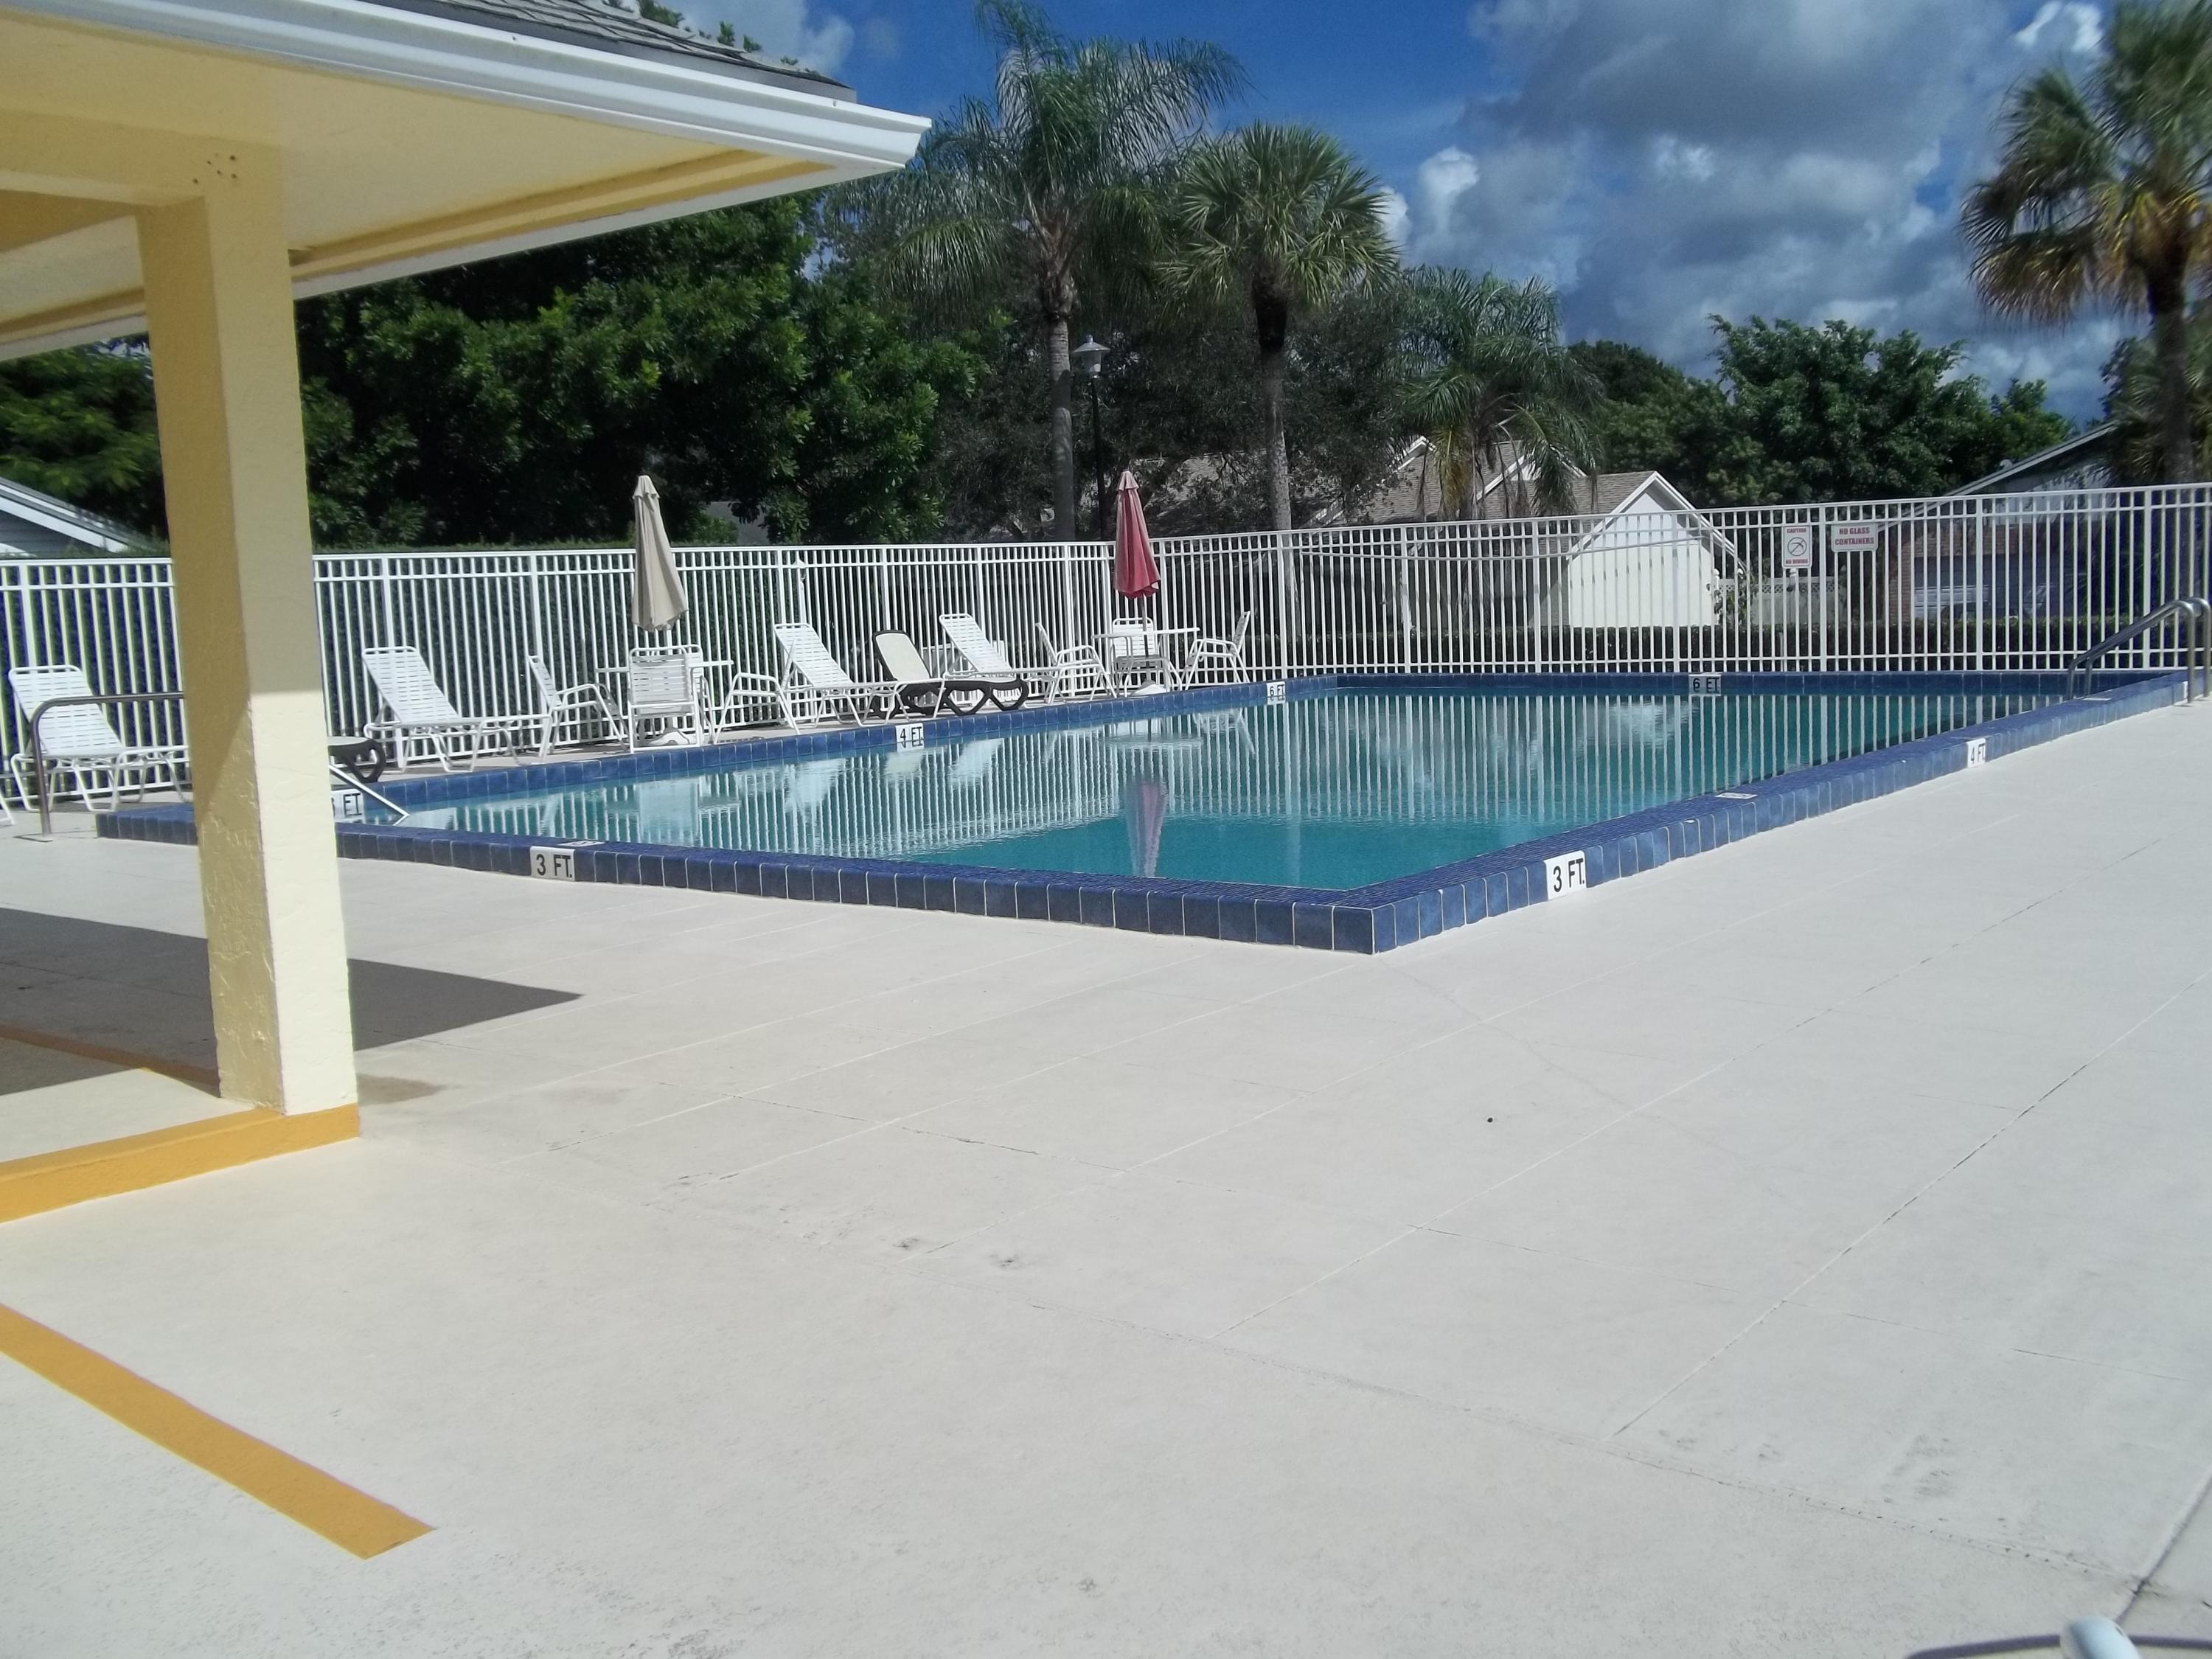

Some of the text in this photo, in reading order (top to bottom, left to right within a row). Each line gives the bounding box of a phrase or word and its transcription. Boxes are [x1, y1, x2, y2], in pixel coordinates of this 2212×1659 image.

[1849, 526, 1870, 535] GLASS
[1834, 538, 1874, 546] CONTAINERS
[1693, 678, 1700, 689] 6
[1270, 686, 1274, 697] 6
[900, 728, 906, 742] 4
[1970, 746, 1975, 765] 4
[536, 854, 572, 878] 3 FT.
[1554, 858, 1585, 892] 3 FT.
